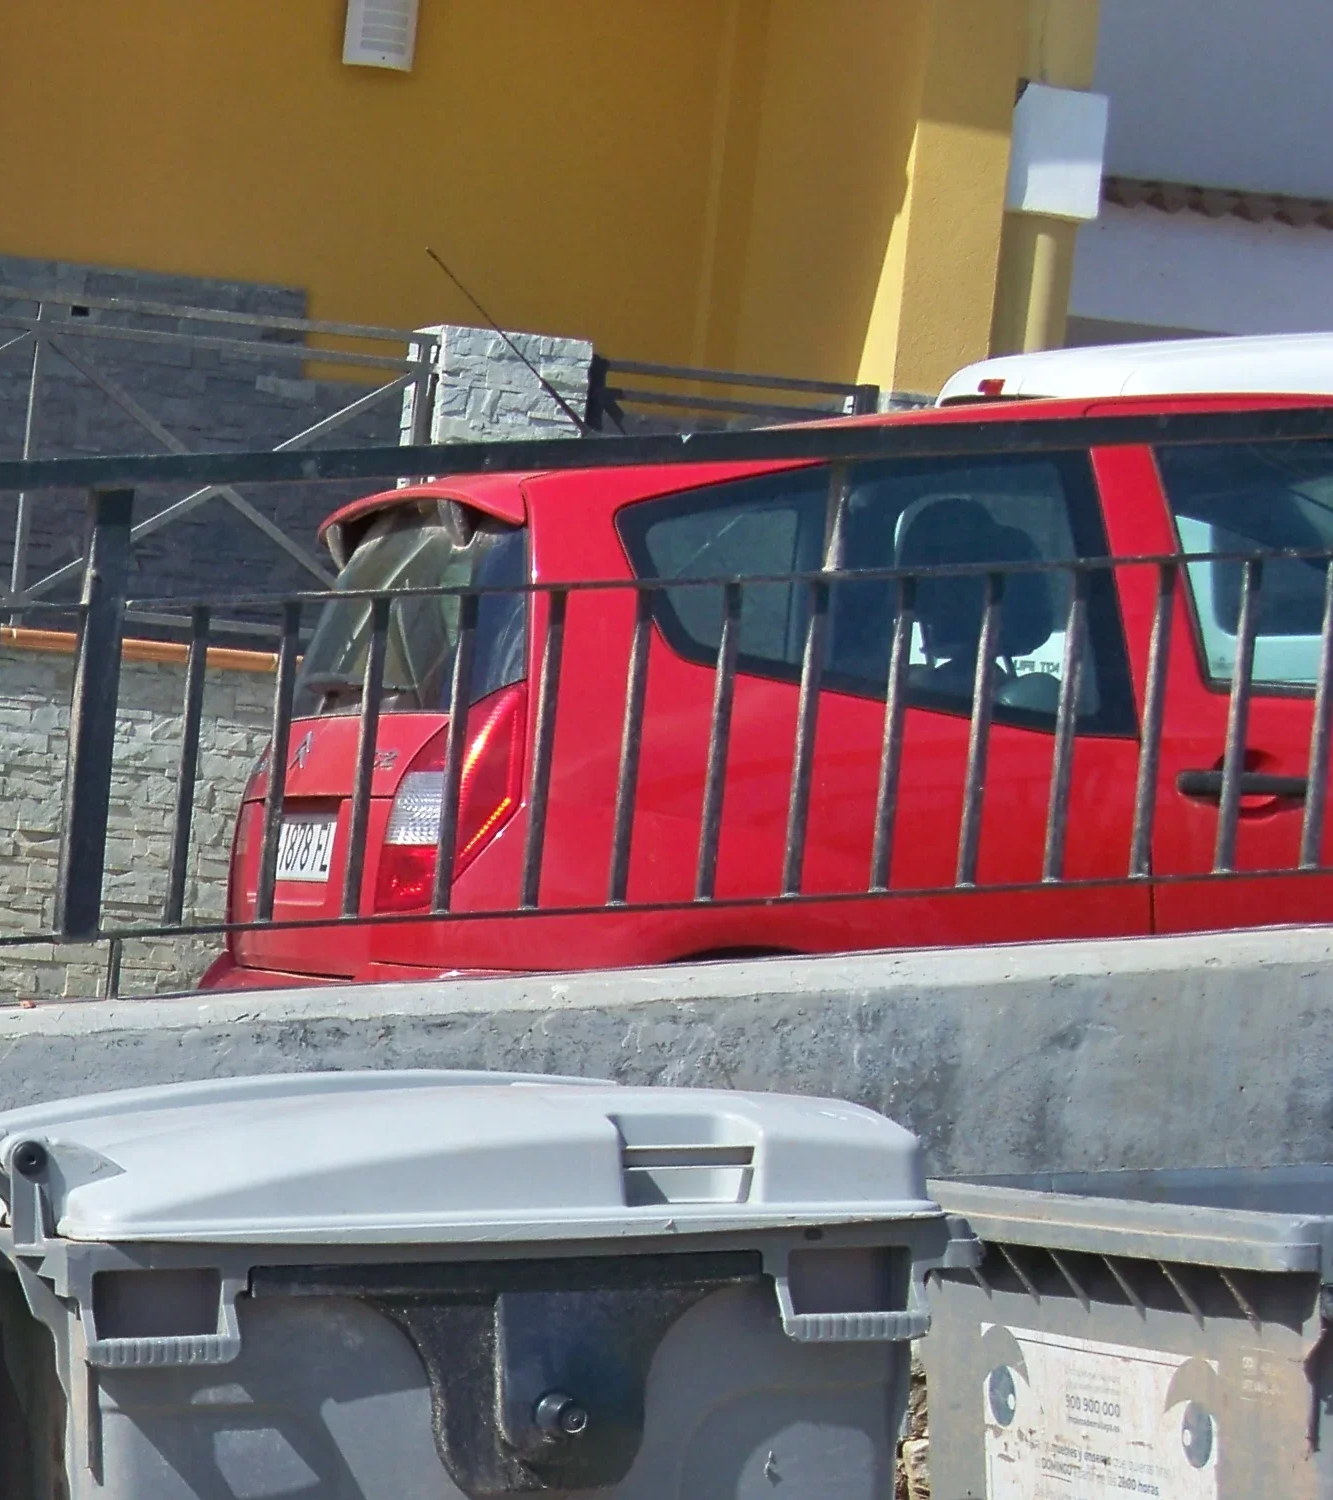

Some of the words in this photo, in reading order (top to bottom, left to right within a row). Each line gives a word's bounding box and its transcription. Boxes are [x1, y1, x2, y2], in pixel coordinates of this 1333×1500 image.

[1065, 1394, 1081, 1410] 900
[1083, 1398, 1100, 1414] 900
[1102, 1401, 1121, 1418] 000
[1041, 1457, 1072, 1476] DOMINGO
